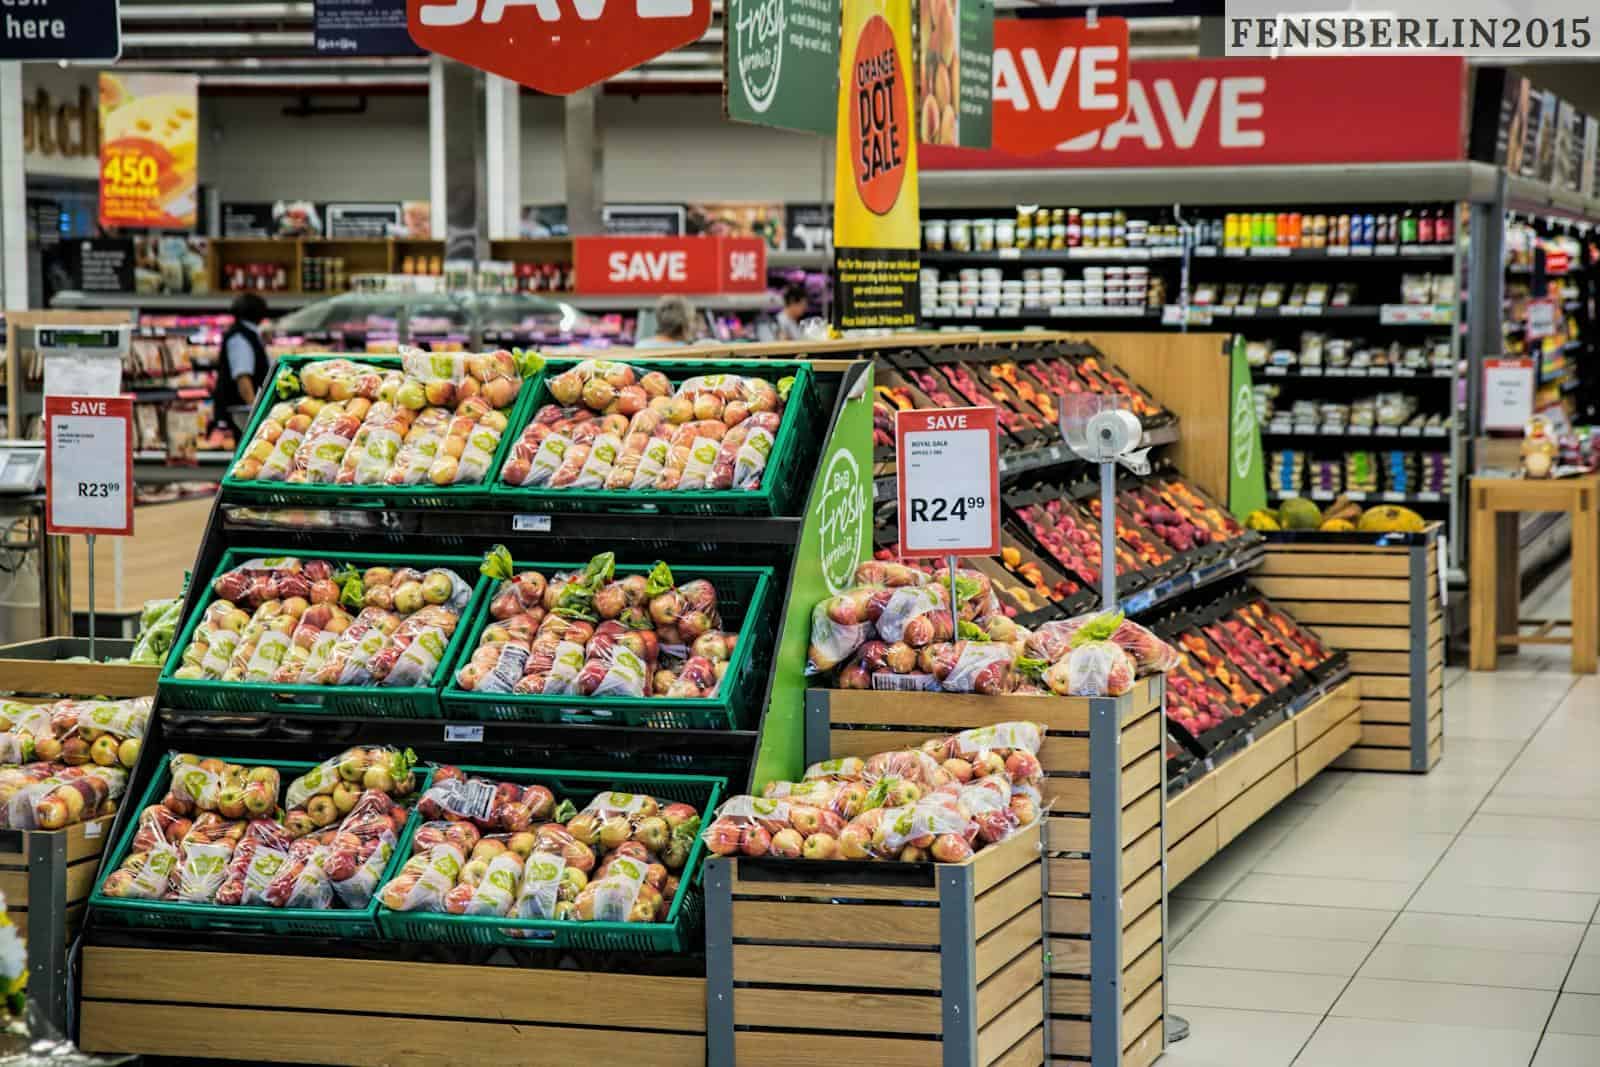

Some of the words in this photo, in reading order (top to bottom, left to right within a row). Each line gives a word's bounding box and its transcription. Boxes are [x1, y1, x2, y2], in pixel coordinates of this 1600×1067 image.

[6, 15, 66, 38] here
[857, 48, 895, 87] ORANGE
[992, 46, 1119, 110] AVE
[859, 77, 896, 138] DOT
[103, 157, 159, 185] 450
[861, 124, 901, 183] SALE
[608, 251, 688, 282] SAVE
[71, 401, 107, 415] SAVE
[927, 415, 968, 430] SAVE
[816, 483, 867, 545] Fresh
